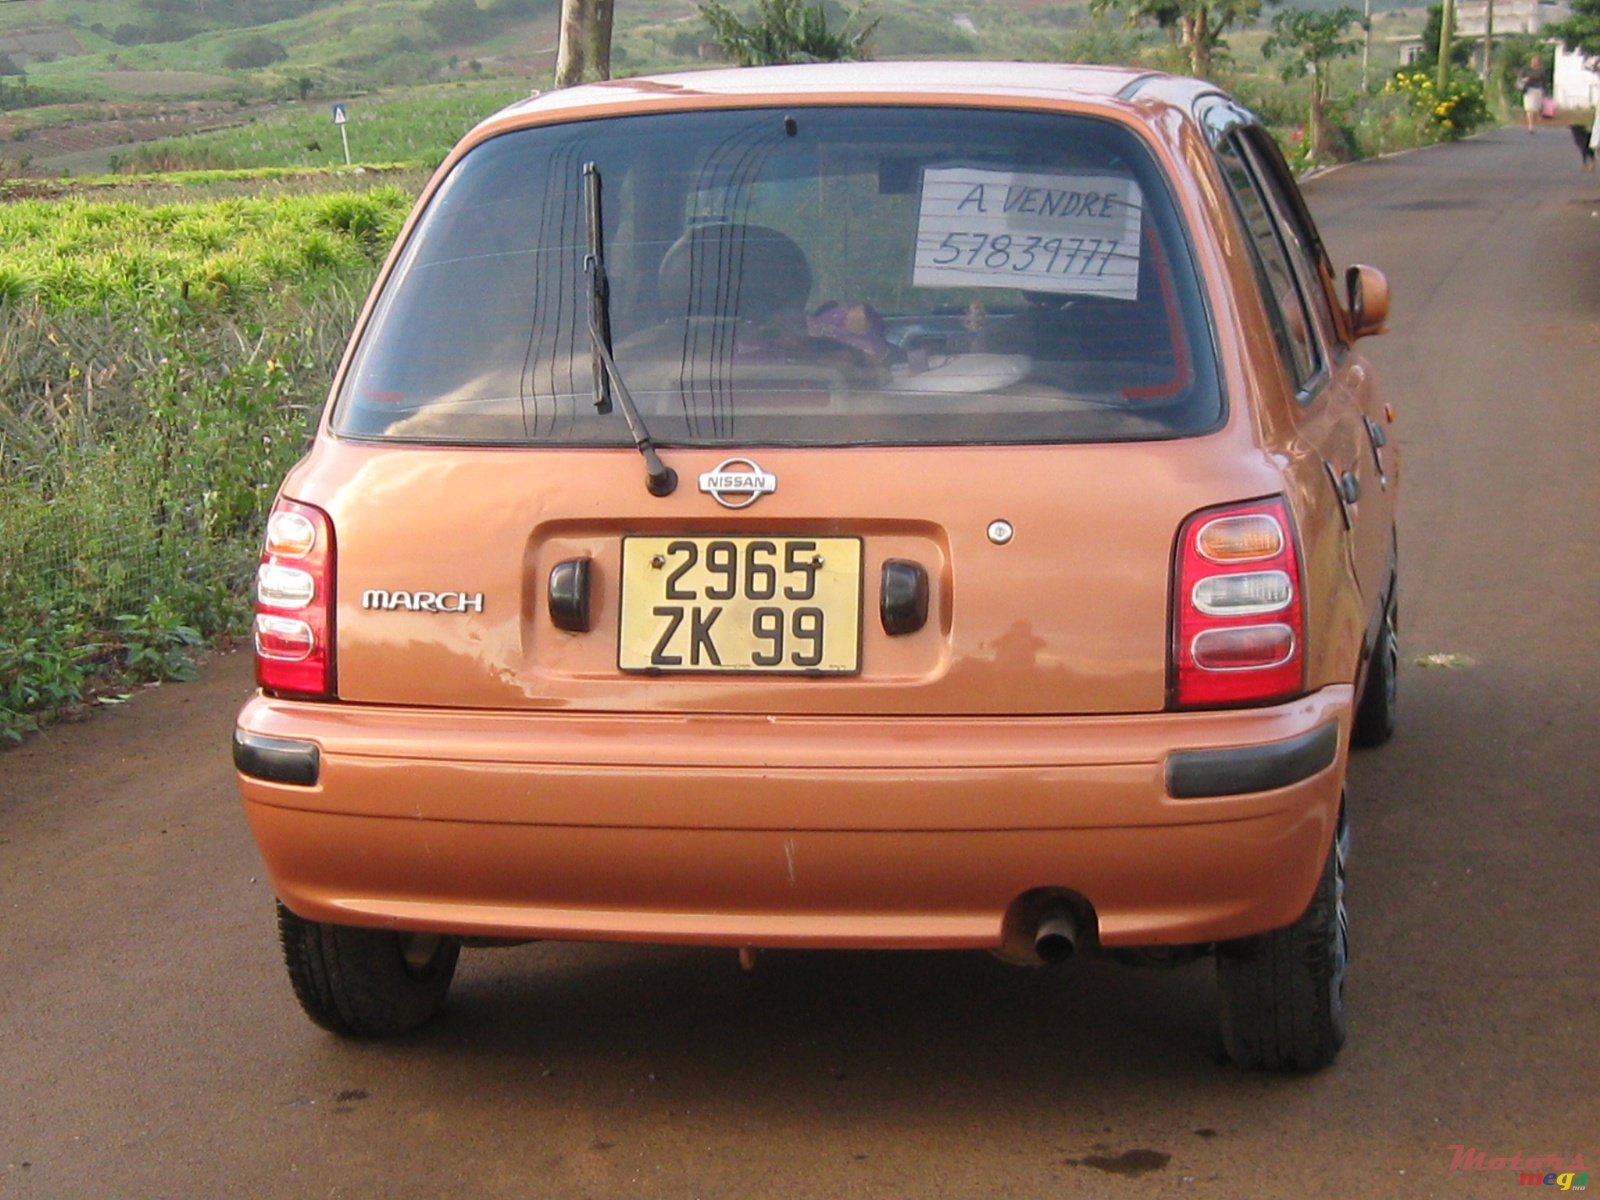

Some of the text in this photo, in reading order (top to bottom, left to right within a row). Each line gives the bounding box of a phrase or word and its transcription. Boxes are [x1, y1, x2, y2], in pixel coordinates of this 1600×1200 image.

[957, 184, 1118, 218] A VENDRE
[933, 232, 1119, 277] 57839777
[707, 476, 765, 488] NISSAN
[666, 541, 817, 600] 2965
[362, 589, 483, 612] MARCH
[651, 606, 824, 666] ZK 99
